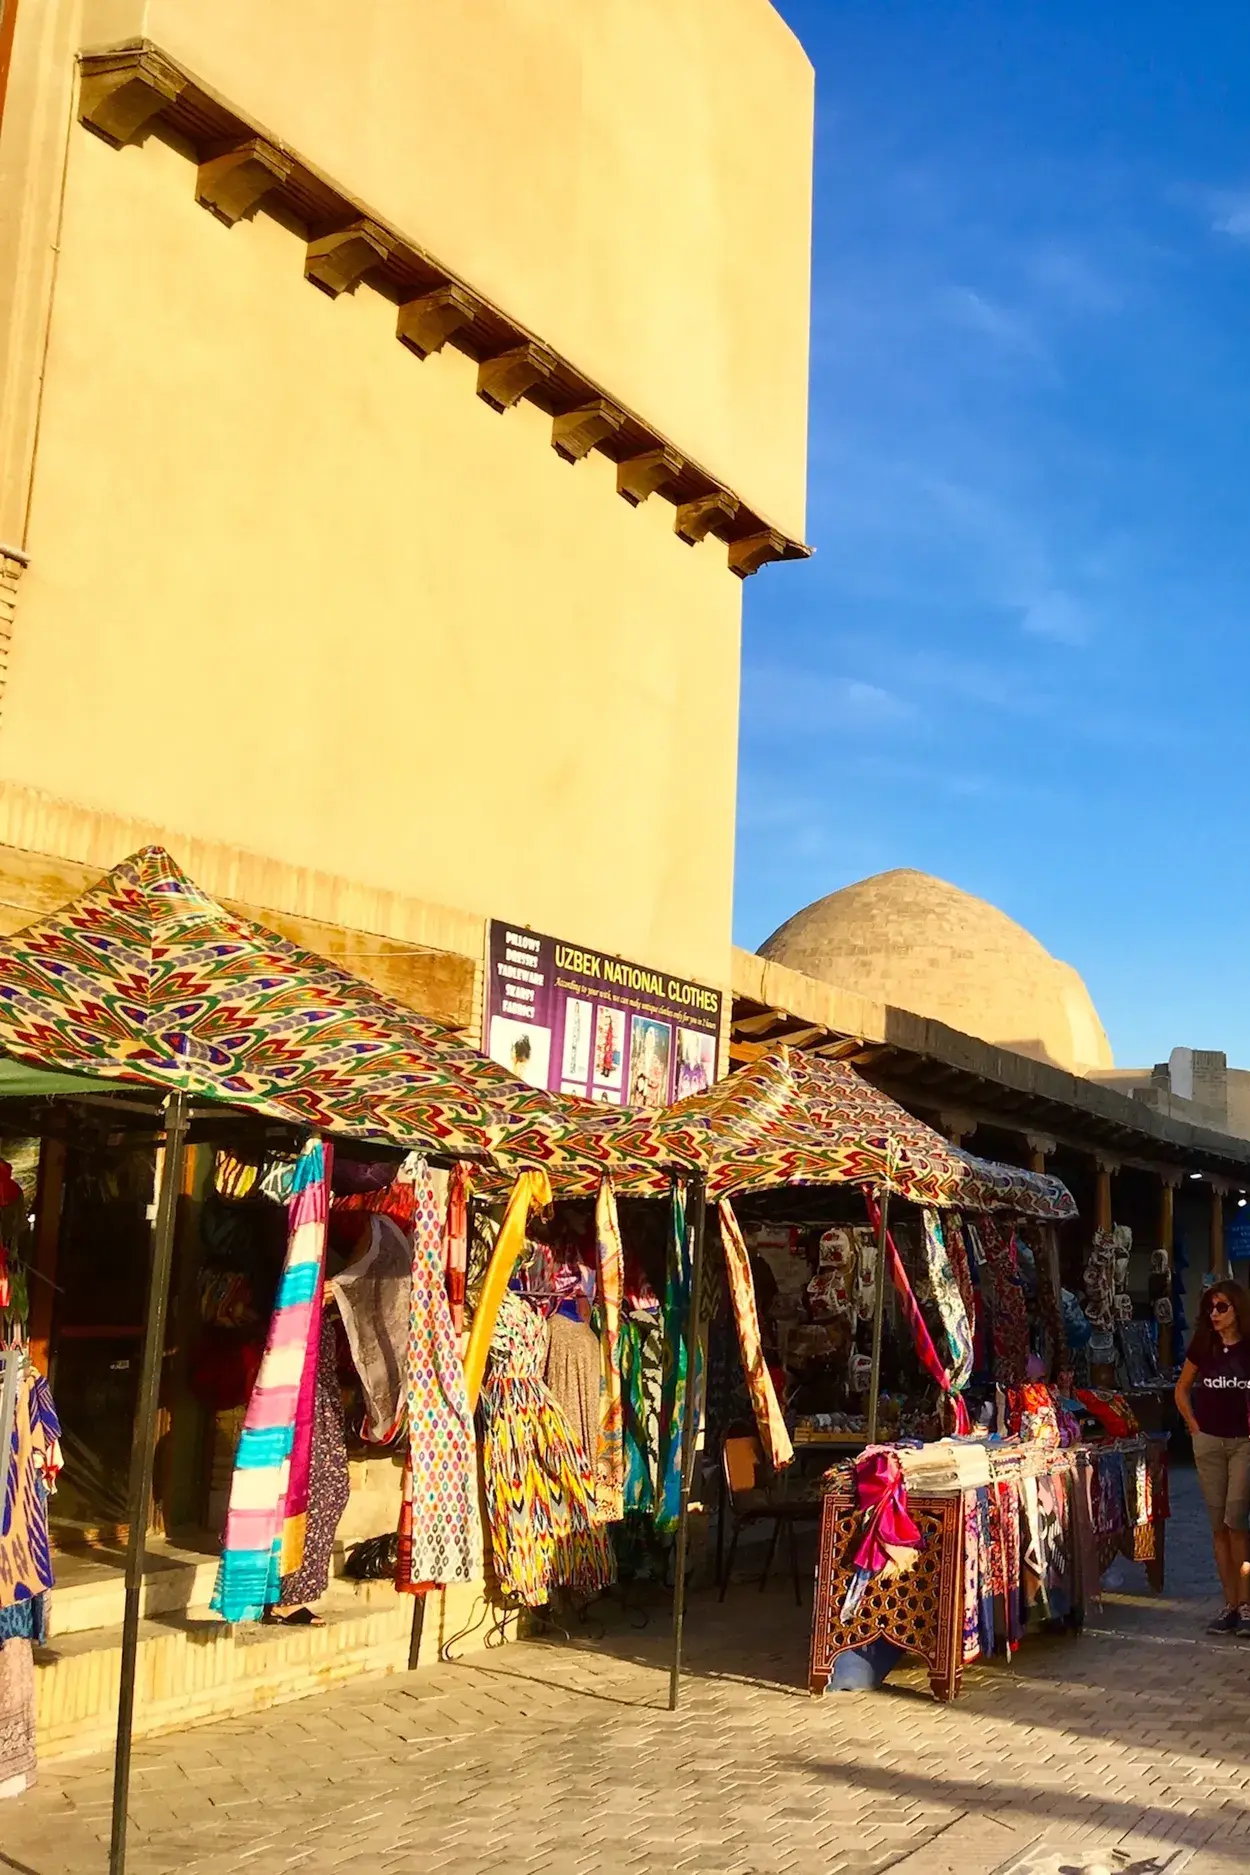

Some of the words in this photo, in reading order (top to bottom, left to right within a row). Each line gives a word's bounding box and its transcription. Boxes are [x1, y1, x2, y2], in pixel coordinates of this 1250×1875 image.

[506, 931, 541, 952] PILLOWS
[555, 945, 601, 978] UZBEK
[604, 960, 666, 997] NATIONAL
[667, 980, 718, 1013] CLOTHES
